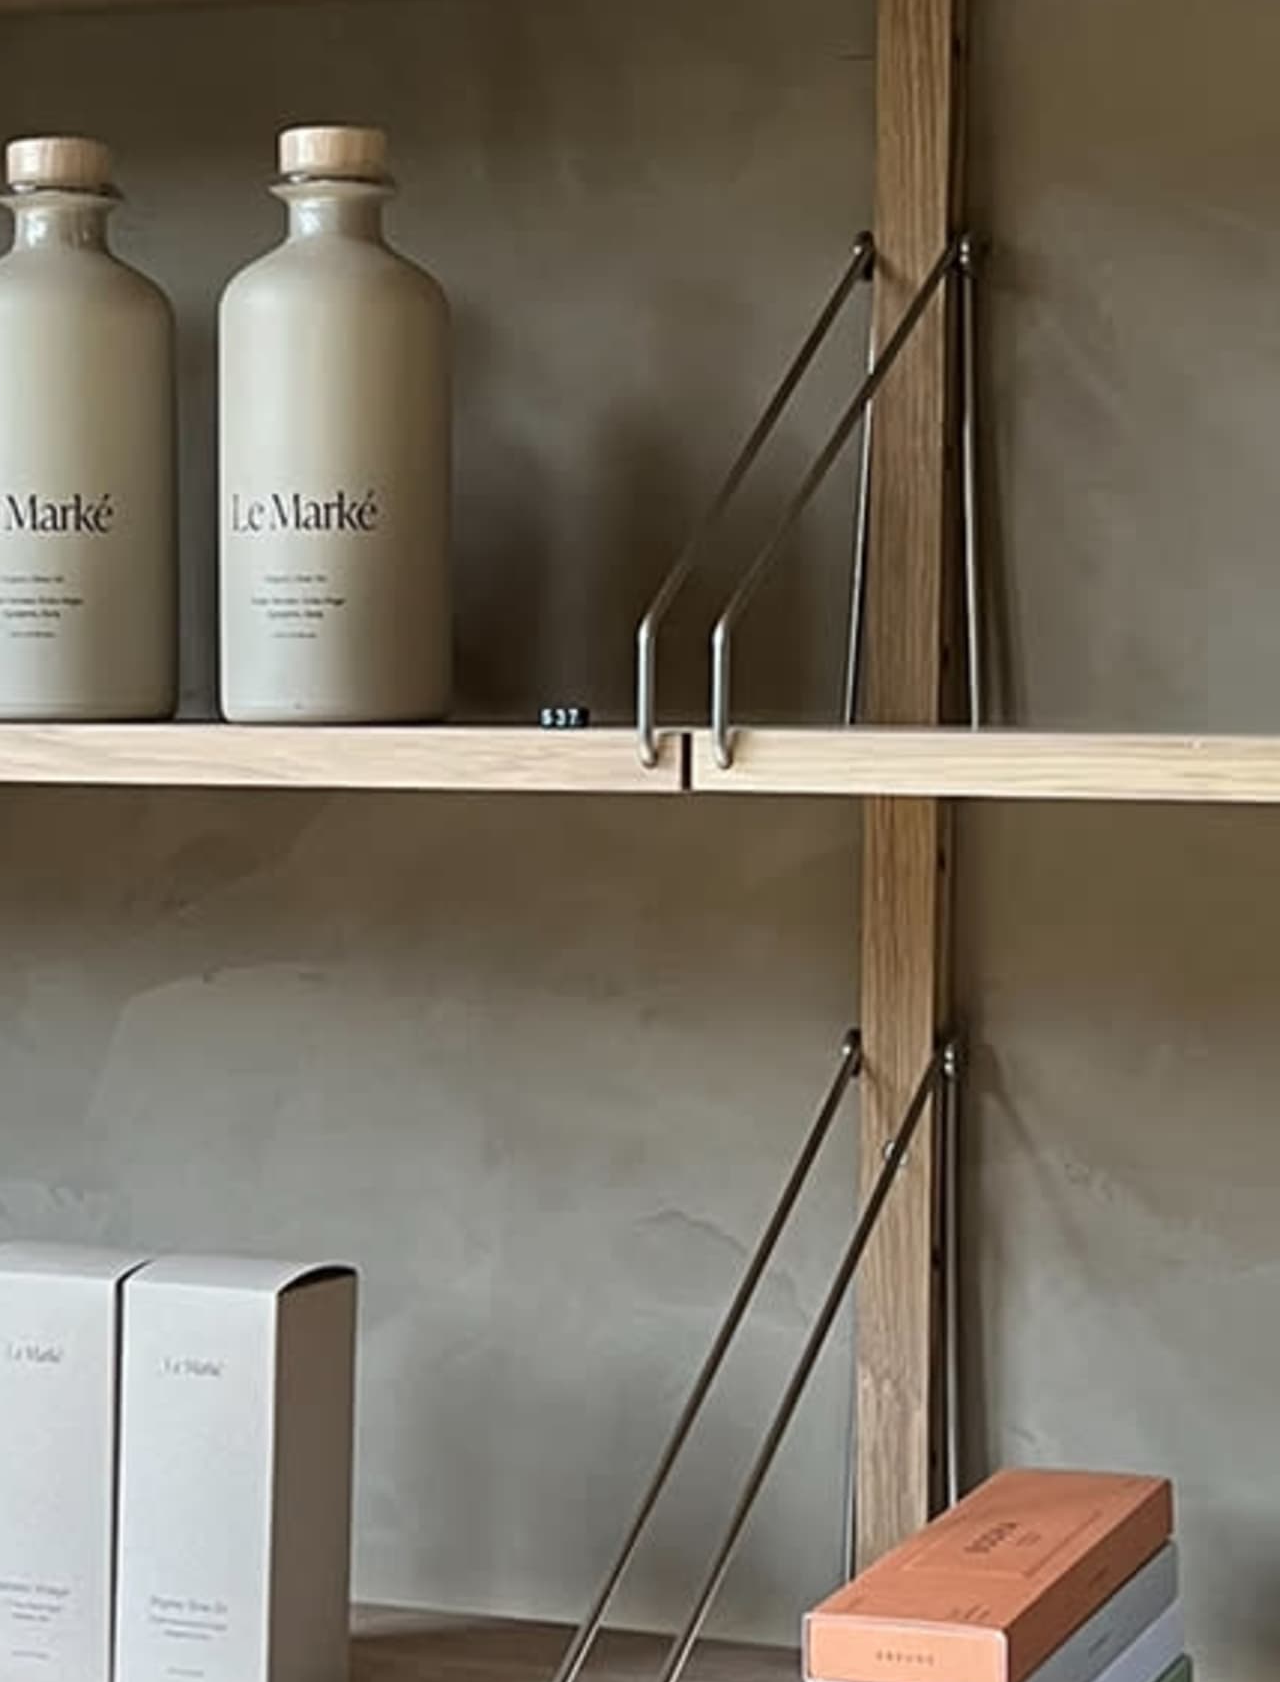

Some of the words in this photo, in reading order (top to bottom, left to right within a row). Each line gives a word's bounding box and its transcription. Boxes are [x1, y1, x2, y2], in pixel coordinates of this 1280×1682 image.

[6, 488, 115, 534] Marké
[231, 493, 265, 534] Le
[270, 487, 378, 534] Marké
